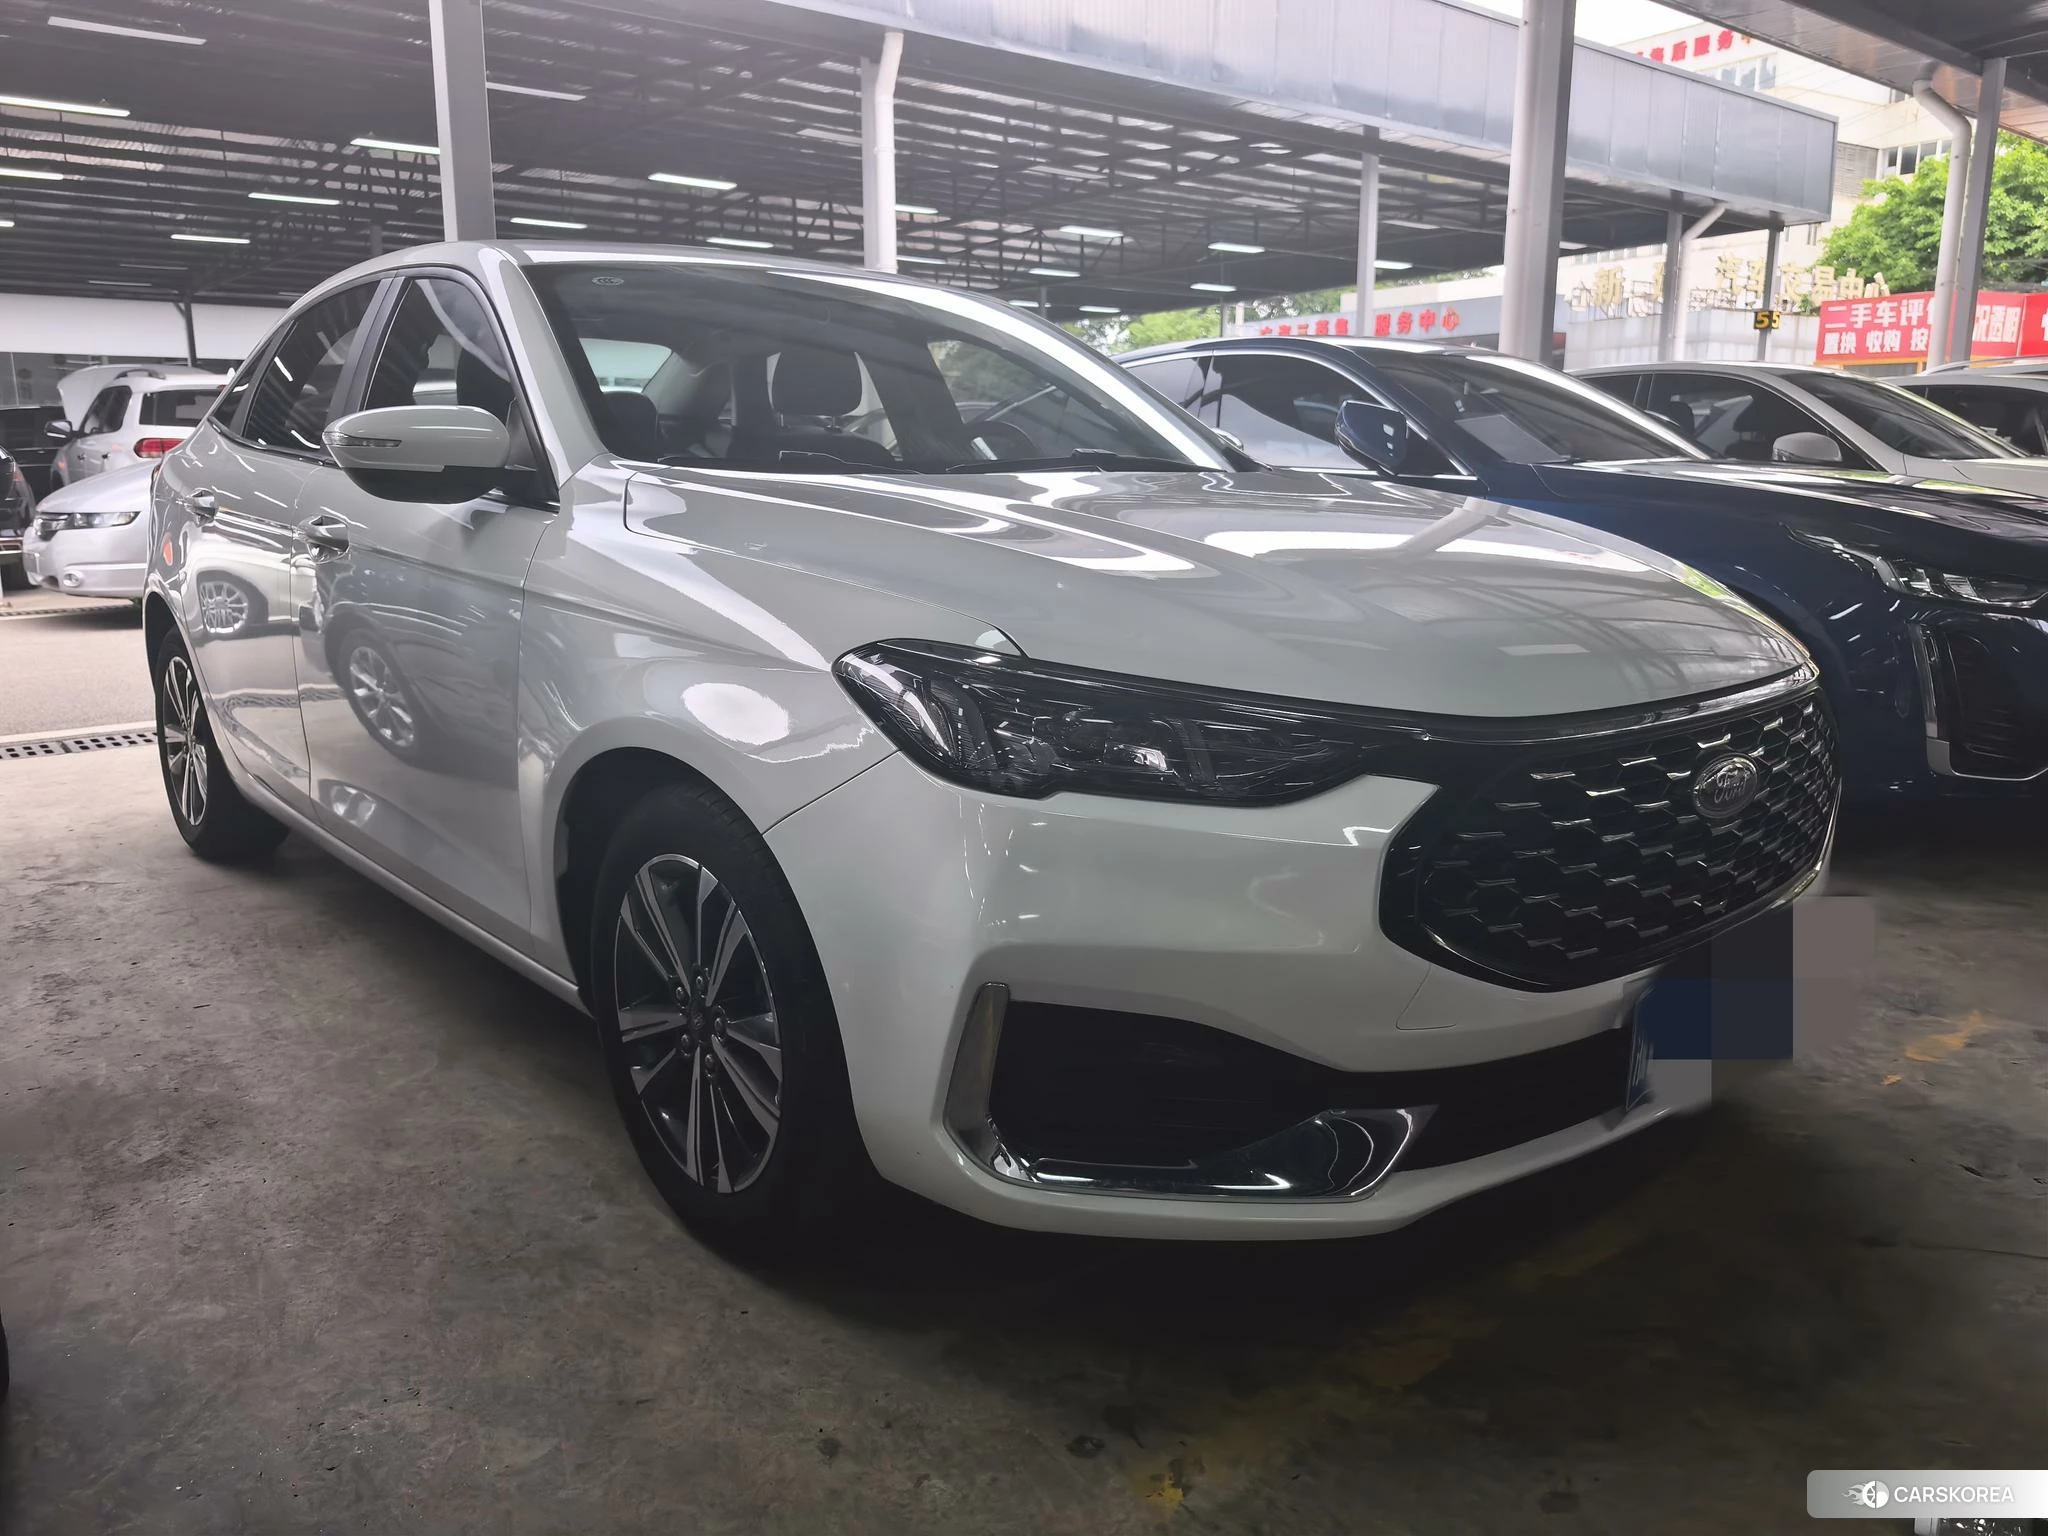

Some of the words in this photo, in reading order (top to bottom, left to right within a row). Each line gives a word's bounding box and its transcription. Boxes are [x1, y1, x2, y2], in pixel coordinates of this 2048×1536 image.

[1755, 311, 1780, 330] 55
[1823, 332, 1856, 355] 置换
[1865, 329, 1901, 353] 收购
